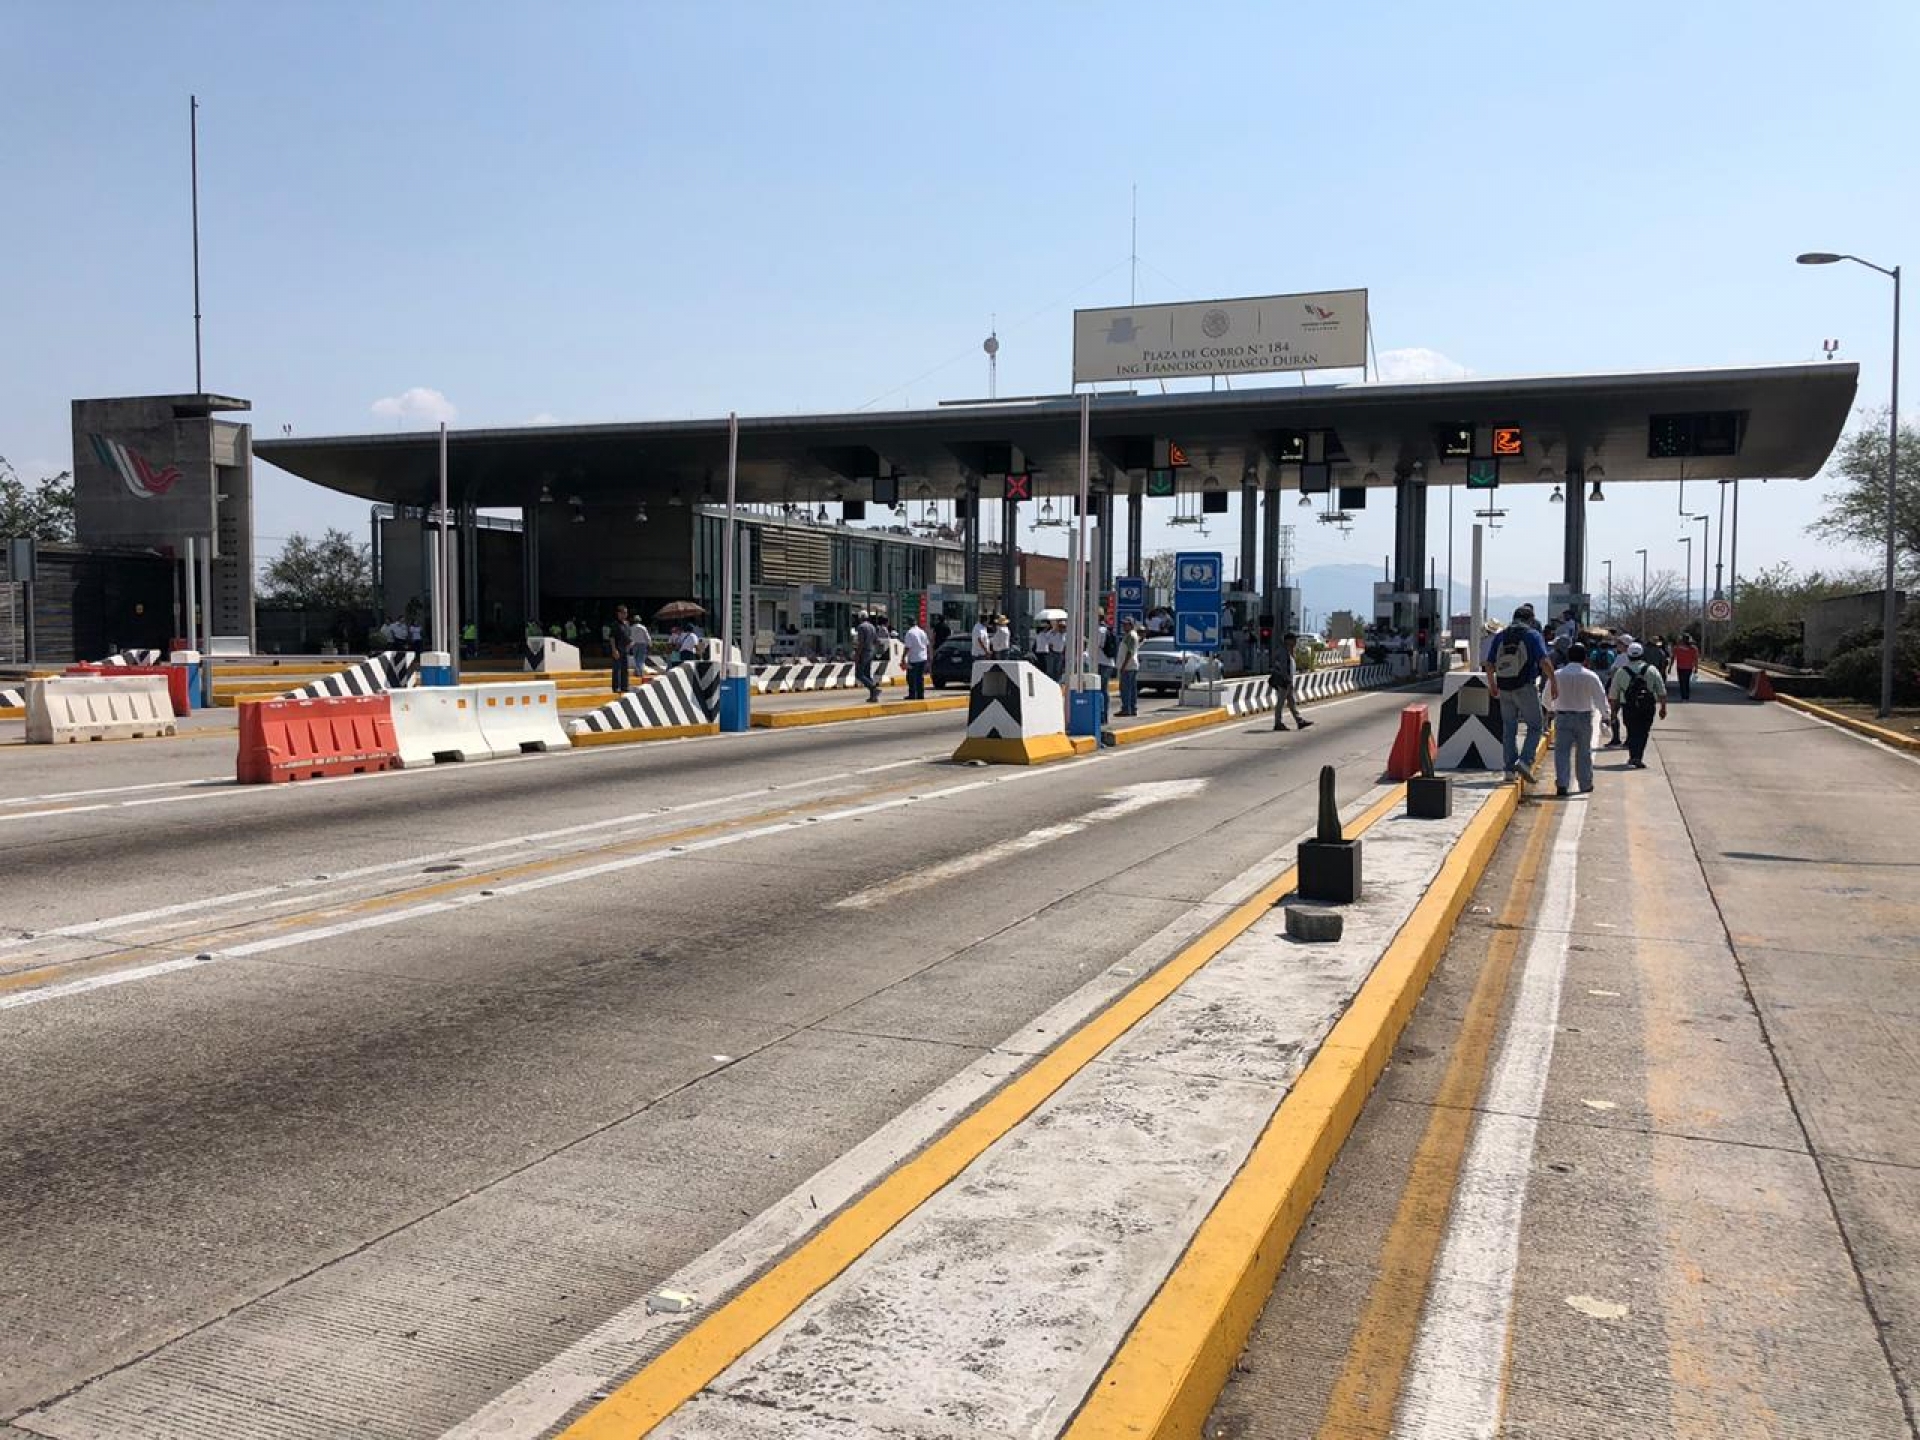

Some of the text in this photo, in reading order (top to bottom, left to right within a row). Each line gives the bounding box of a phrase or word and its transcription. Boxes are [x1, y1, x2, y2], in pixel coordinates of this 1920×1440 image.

[1142, 349, 1178, 361] PLAZA
[1182, 348, 1196, 359] DE
[1200, 345, 1244, 358] COBRO
[1269, 341, 1290, 353] 184
[1145, 360, 1213, 373] FRANCISCO
[1218, 356, 1268, 370] VELASCO
